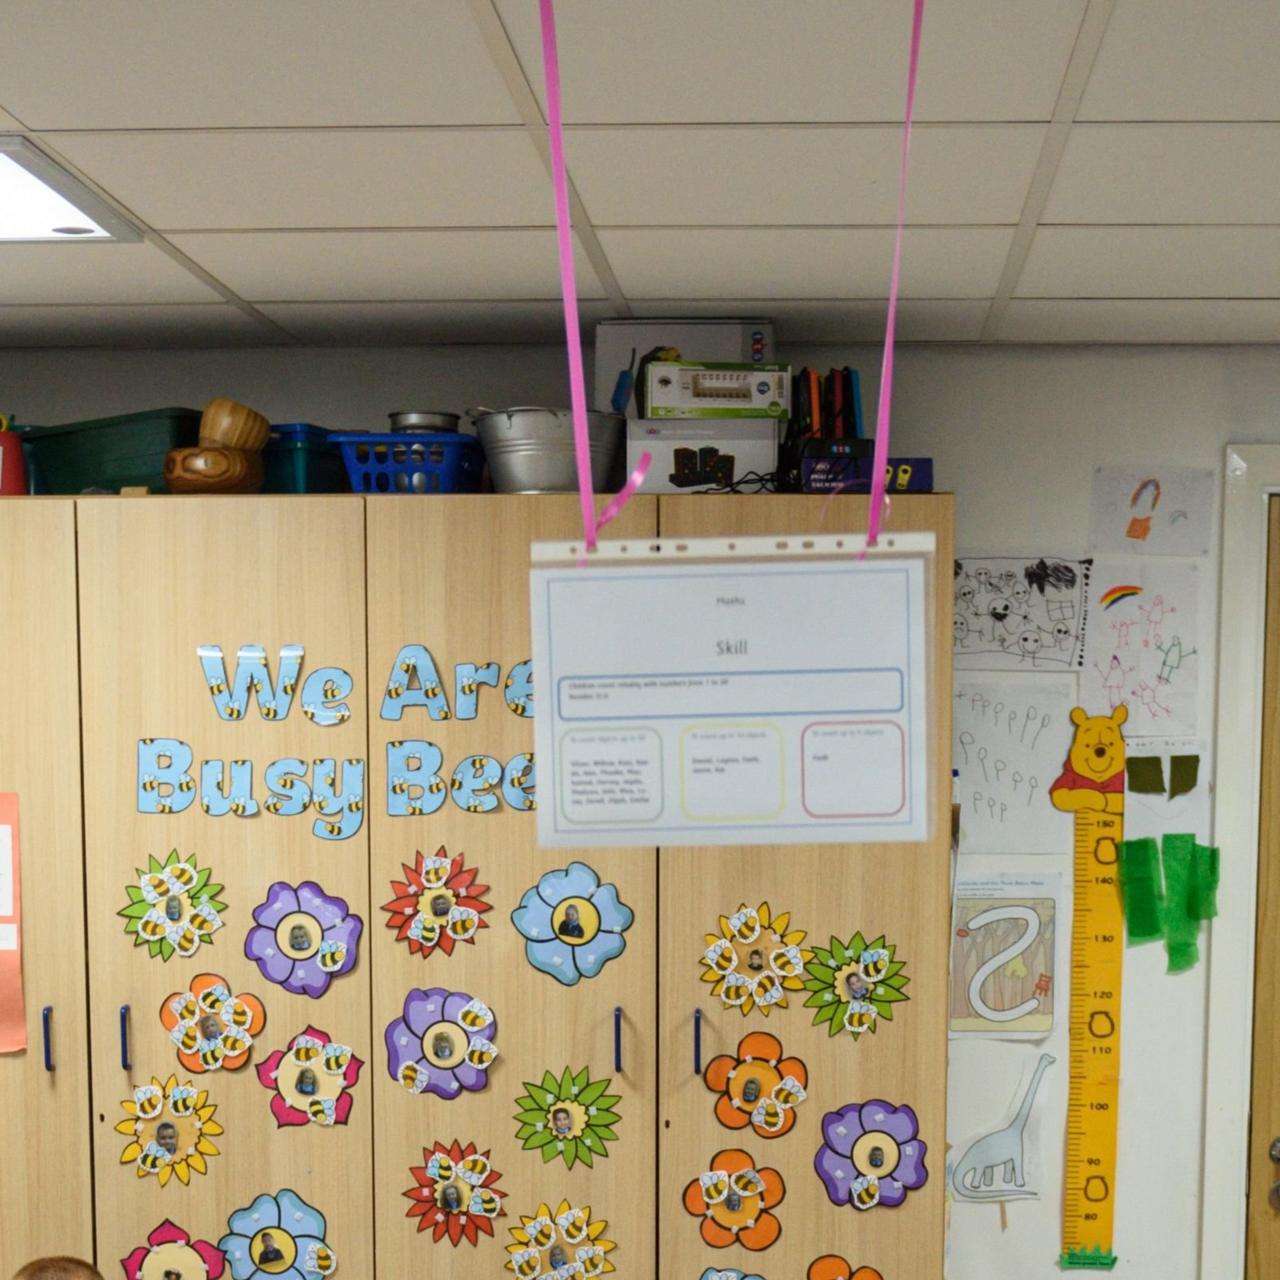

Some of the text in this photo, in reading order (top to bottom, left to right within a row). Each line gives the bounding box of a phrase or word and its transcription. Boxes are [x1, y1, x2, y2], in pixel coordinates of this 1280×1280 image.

[716, 639, 749, 656] Skill
[197, 645, 354, 726] We
[137, 738, 365, 840] Busy
[1096, 820, 1115, 828] 150
[1095, 877, 1113, 885] 140
[1094, 934, 1114, 943] 130
[1093, 991, 1112, 999] 120
[1091, 1047, 1111, 1055] 110
[1089, 1102, 1109, 1111] 100
[1087, 1158, 1101, 1166] 90
[1083, 1213, 1098, 1221] 80
